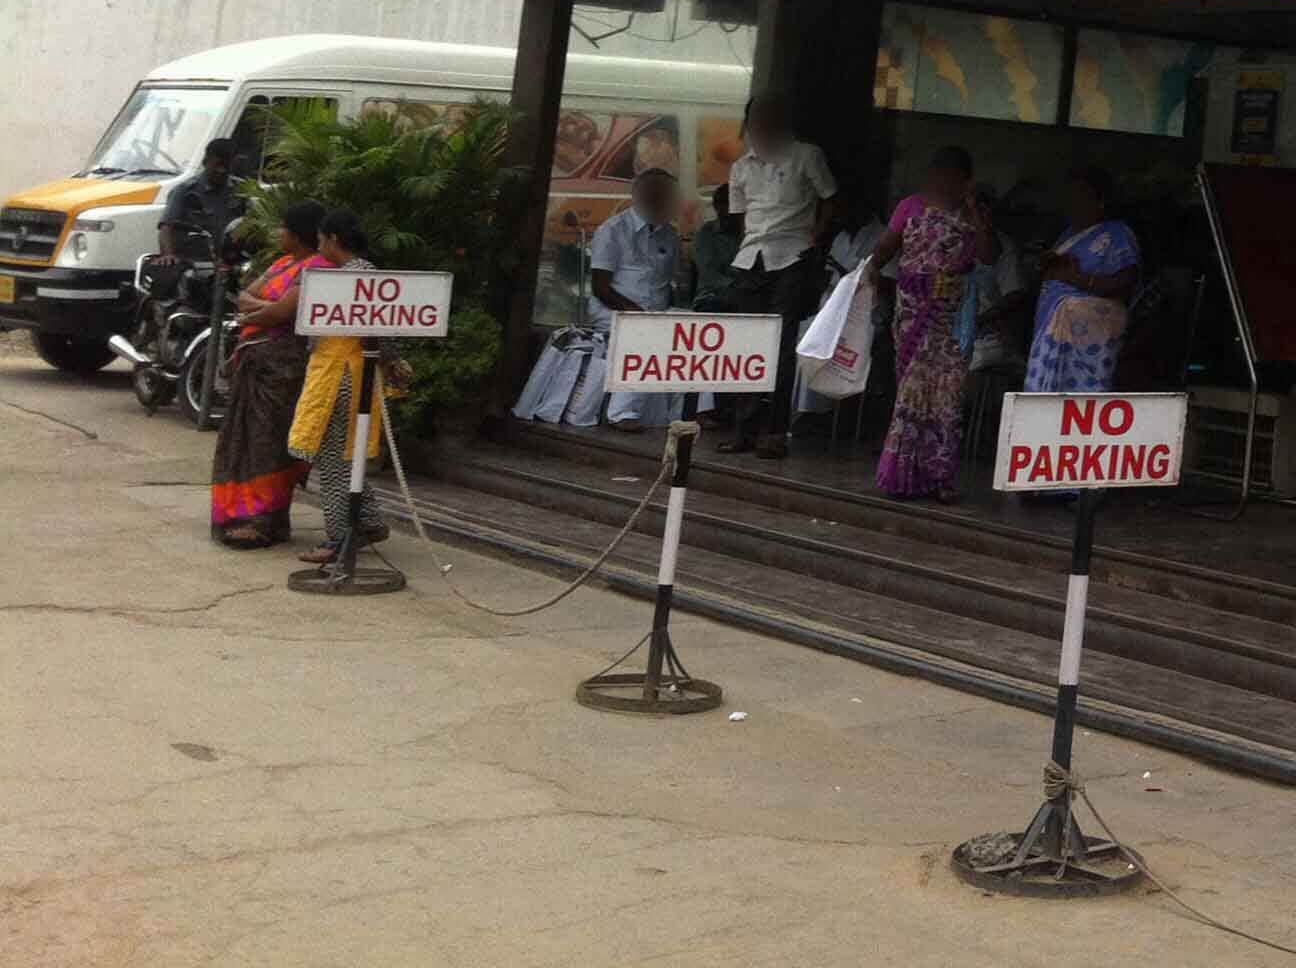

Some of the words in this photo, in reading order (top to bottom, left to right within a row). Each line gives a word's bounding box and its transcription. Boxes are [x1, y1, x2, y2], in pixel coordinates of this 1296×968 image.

[355, 279, 401, 302] NO
[310, 304, 438, 327] PARKING
[673, 322, 725, 352] NO
[621, 354, 766, 381] PARKING
[1060, 398, 1135, 436] NO
[1008, 444, 1170, 482] PARKING
